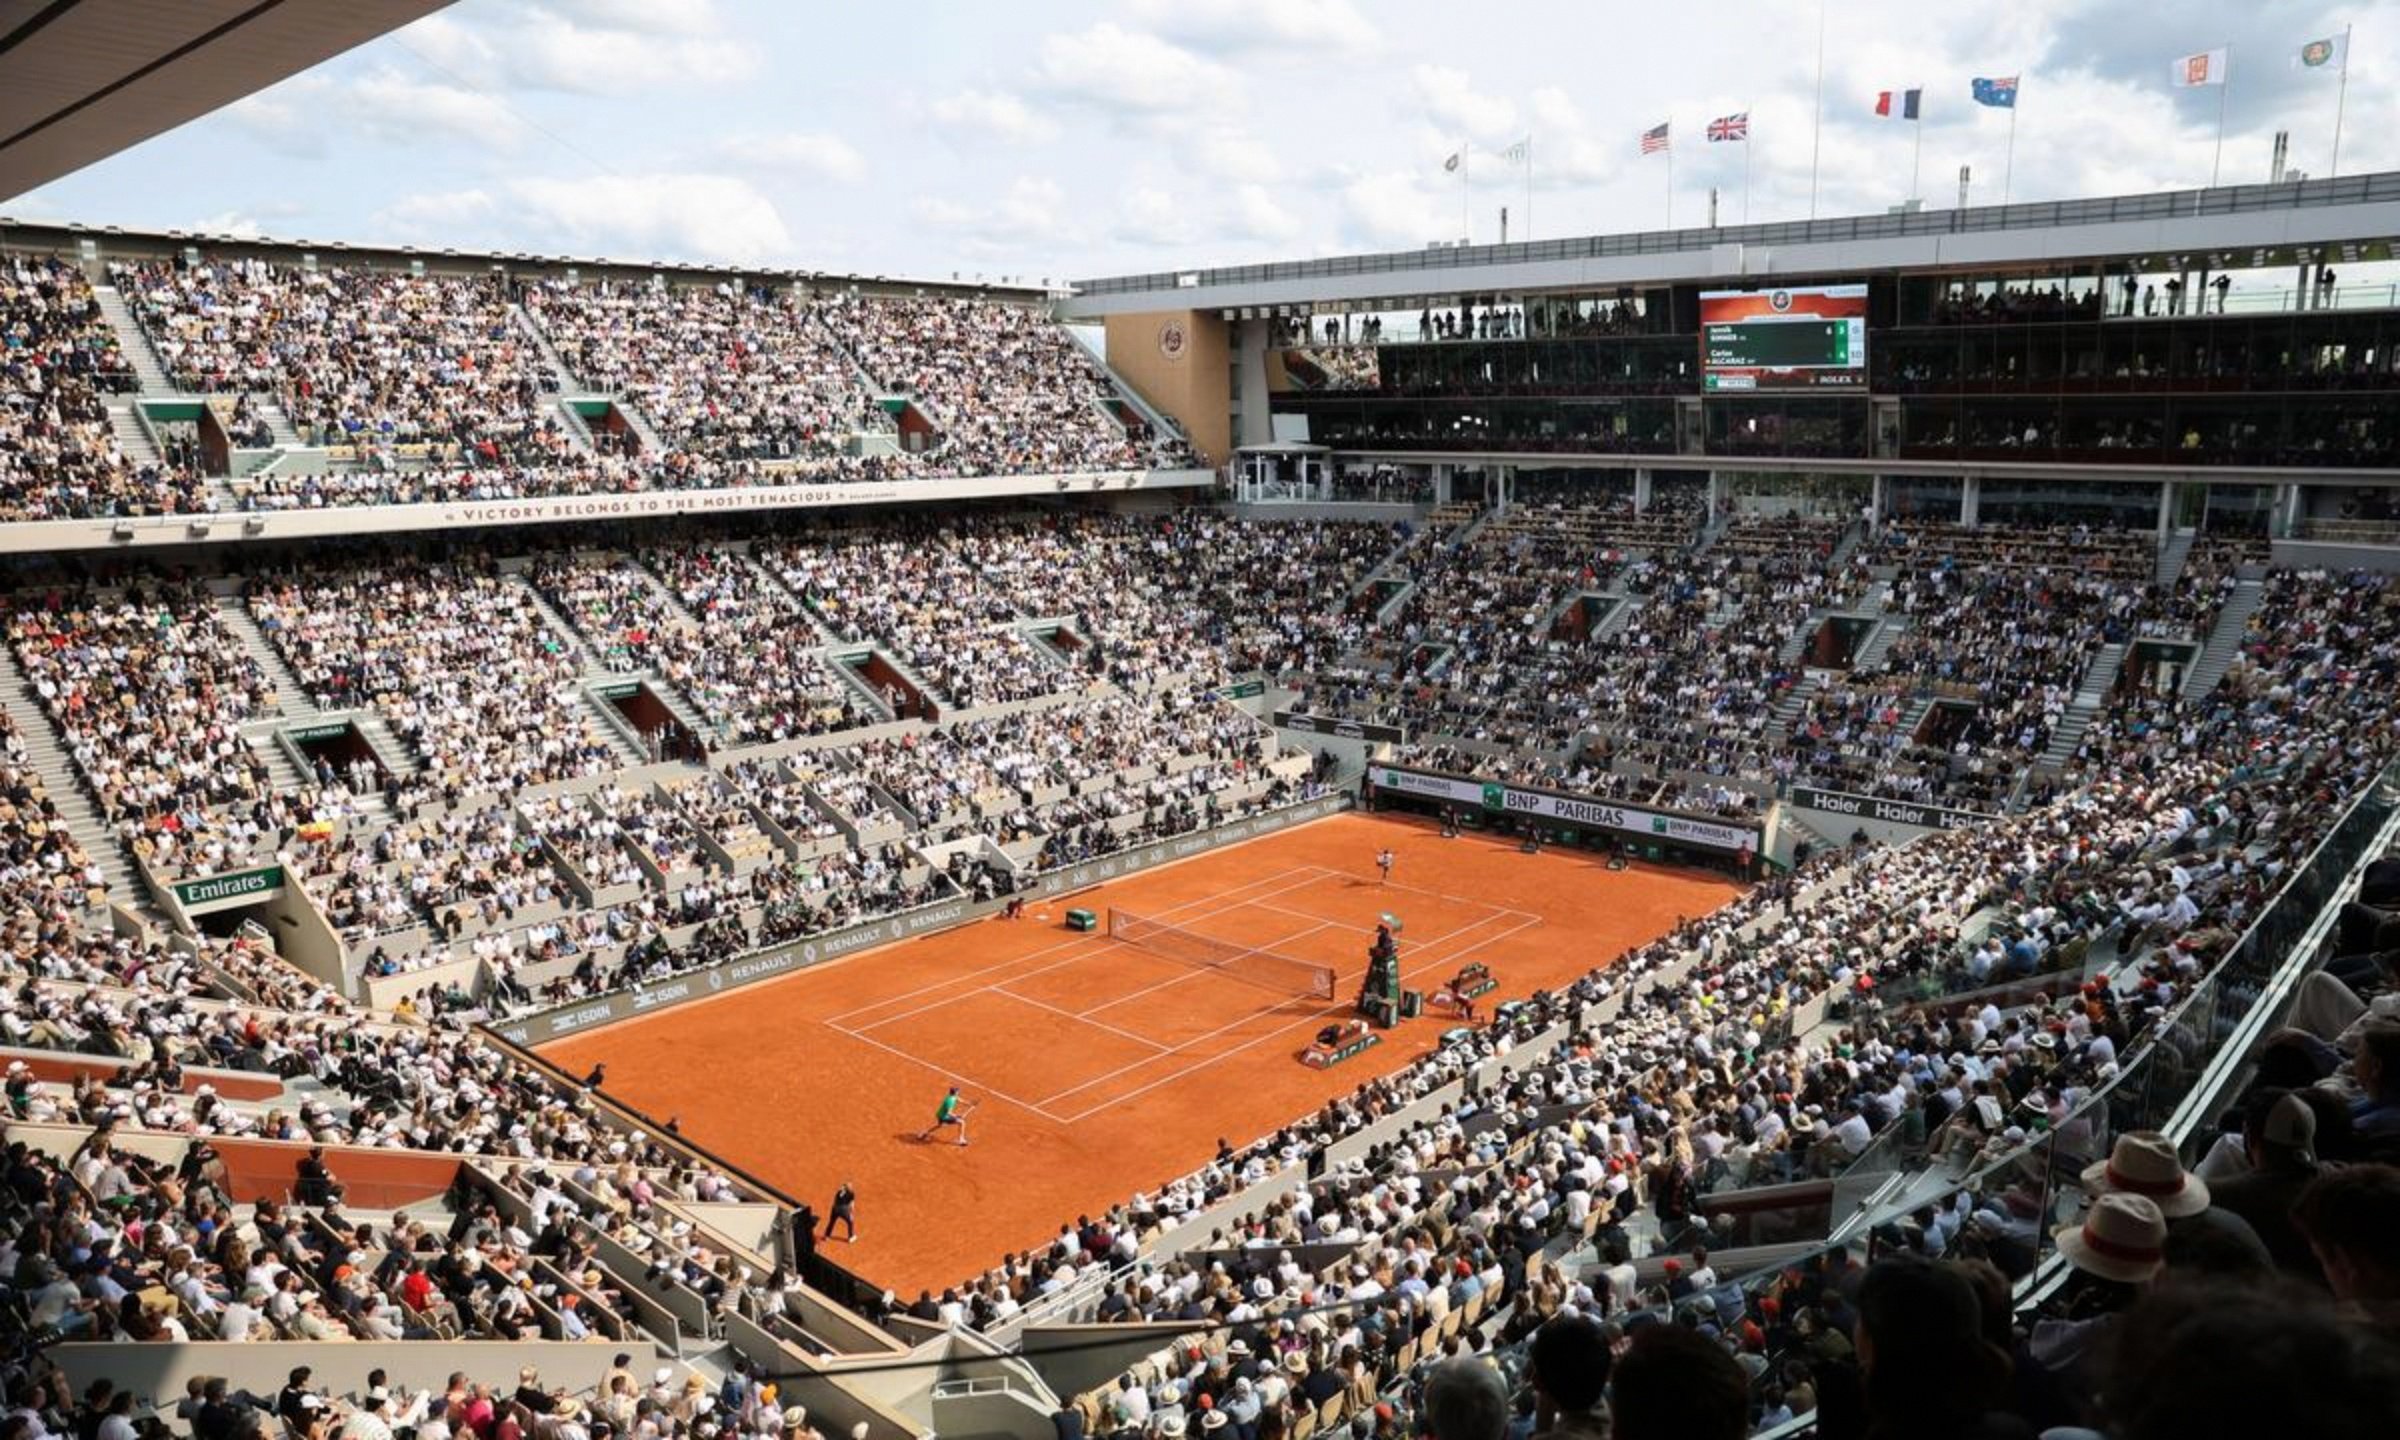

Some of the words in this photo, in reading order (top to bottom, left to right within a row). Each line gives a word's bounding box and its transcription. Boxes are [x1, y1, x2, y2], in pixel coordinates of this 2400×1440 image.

[1820, 375, 1852, 385] ROLEX
[463, 507, 545, 521] VICTORY
[553, 501, 631, 516] BELONGS
[639, 500, 658, 511] TO
[667, 498, 694, 510] THE
[703, 495, 743, 507] MOST
[751, 491, 832, 505] TENACIOUS
[1507, 791, 1539, 810] BNP
[1555, 801, 1625, 827] PARIBAS
[1813, 793, 1861, 814] Haier
[1875, 802, 1925, 823] Haier
[1669, 820, 1690, 832] BNP
[1691, 824, 1734, 841] PARIBAS
[187, 875, 266, 901] Emirates
[909, 905, 962, 928] RENAULT
[824, 928, 881, 953] RENAULT
[731, 952, 794, 980] RENAULT
[656, 983, 689, 1002] ISDIN
[577, 1004, 611, 1025] ISDIN
